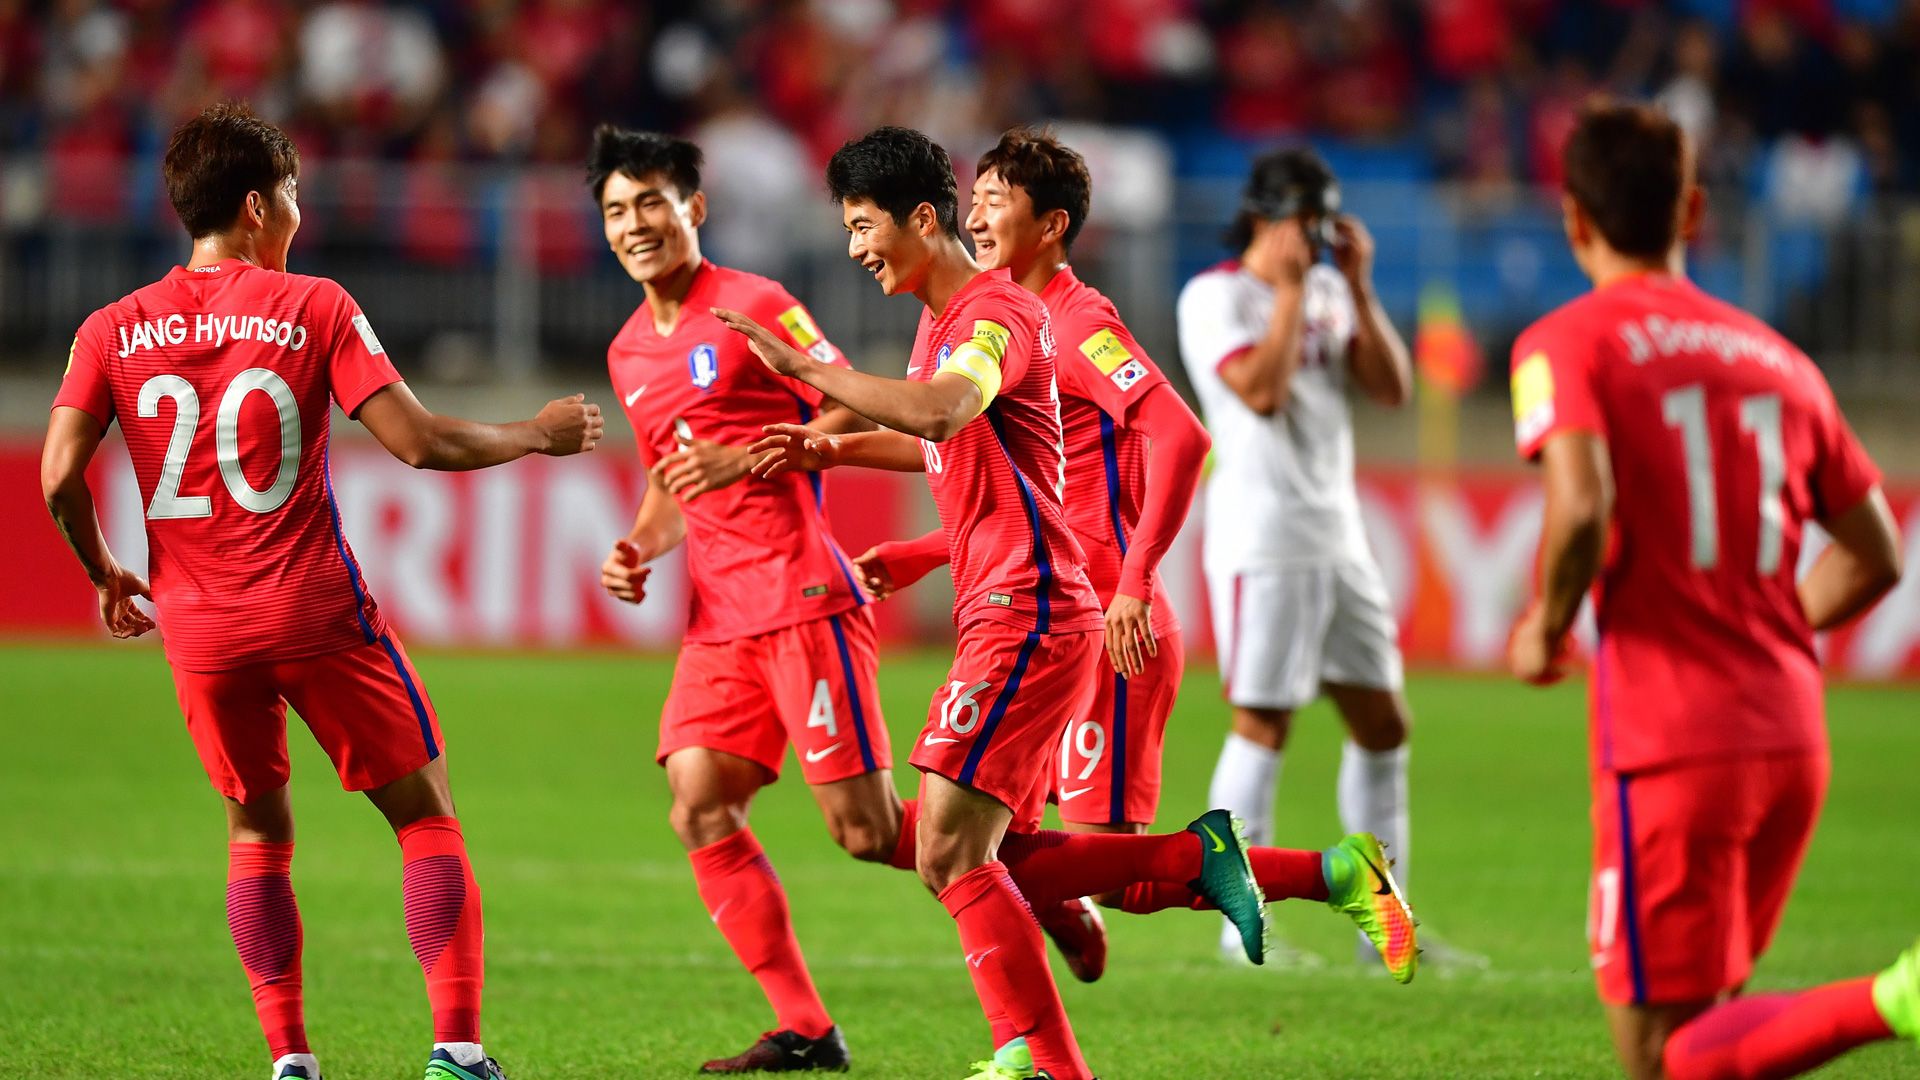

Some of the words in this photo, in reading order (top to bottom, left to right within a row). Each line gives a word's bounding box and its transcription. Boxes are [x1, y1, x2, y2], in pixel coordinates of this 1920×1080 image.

[194, 265, 221, 273] KOREA
[117, 313, 187, 359] JANG
[195, 313, 307, 351] Hyunsoo
[1091, 344, 1110, 361] FIFA
[138, 367, 301, 519] 20
[1662, 384, 1783, 575] 11
[806, 679, 838, 737] 4
[940, 680, 991, 734] 16
[1062, 720, 1106, 780] 19
